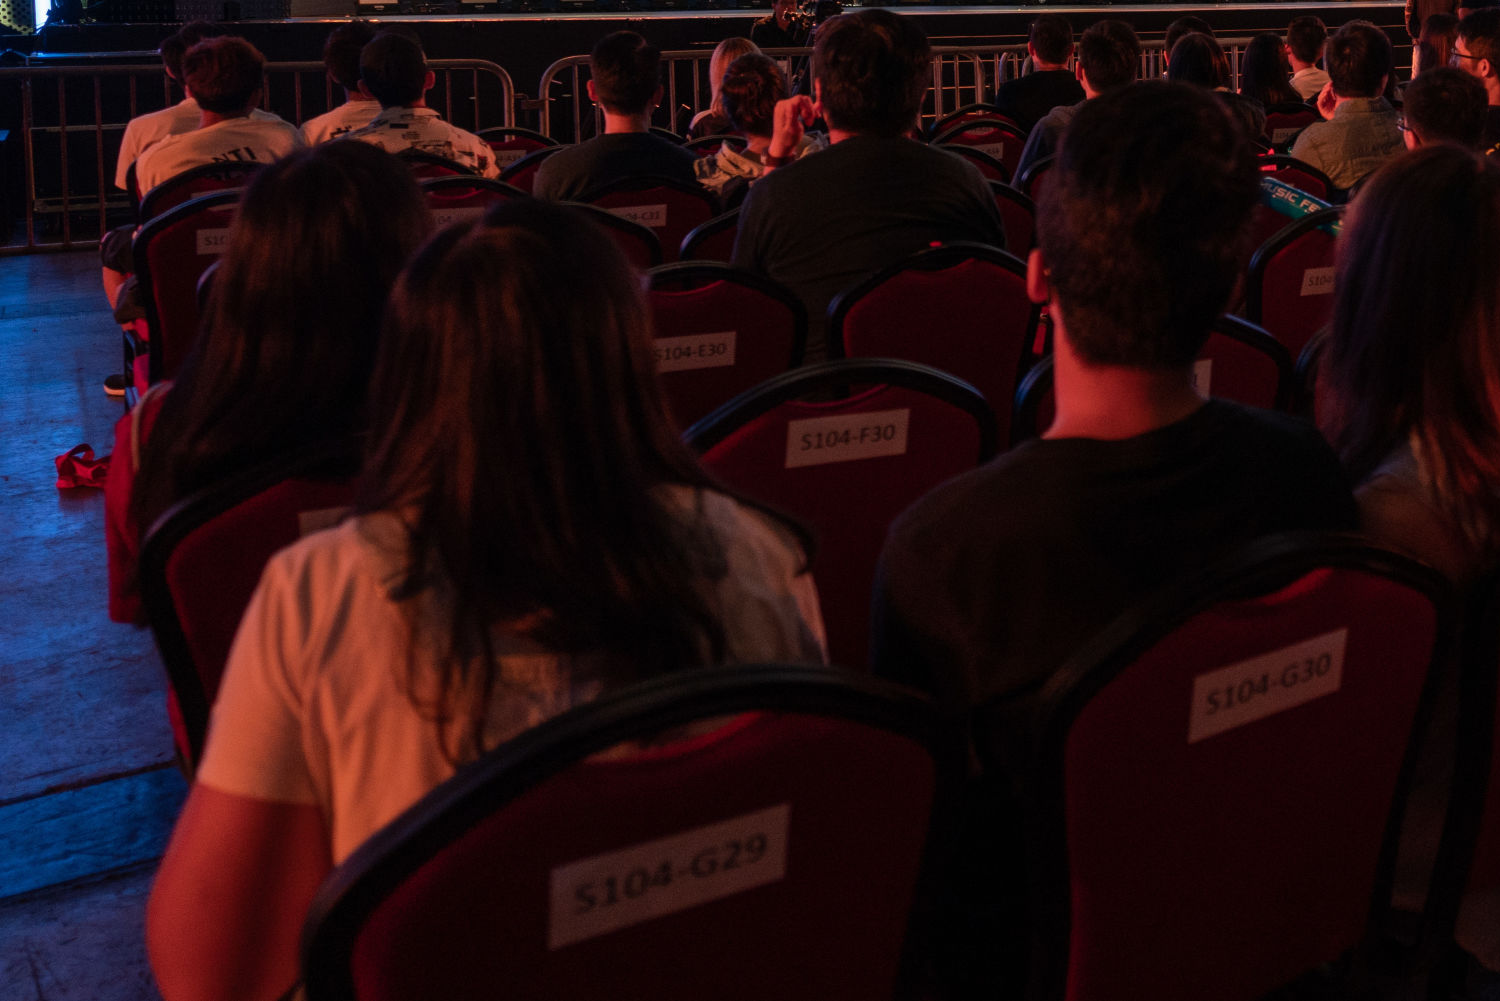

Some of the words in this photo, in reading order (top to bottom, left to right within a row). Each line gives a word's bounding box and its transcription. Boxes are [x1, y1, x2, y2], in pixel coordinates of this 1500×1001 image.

[654, 343, 727, 361] S104-E30
[801, 424, 896, 451] S104-F30
[1207, 653, 1332, 715] S104-G30
[576, 832, 768, 914] S104-G29
